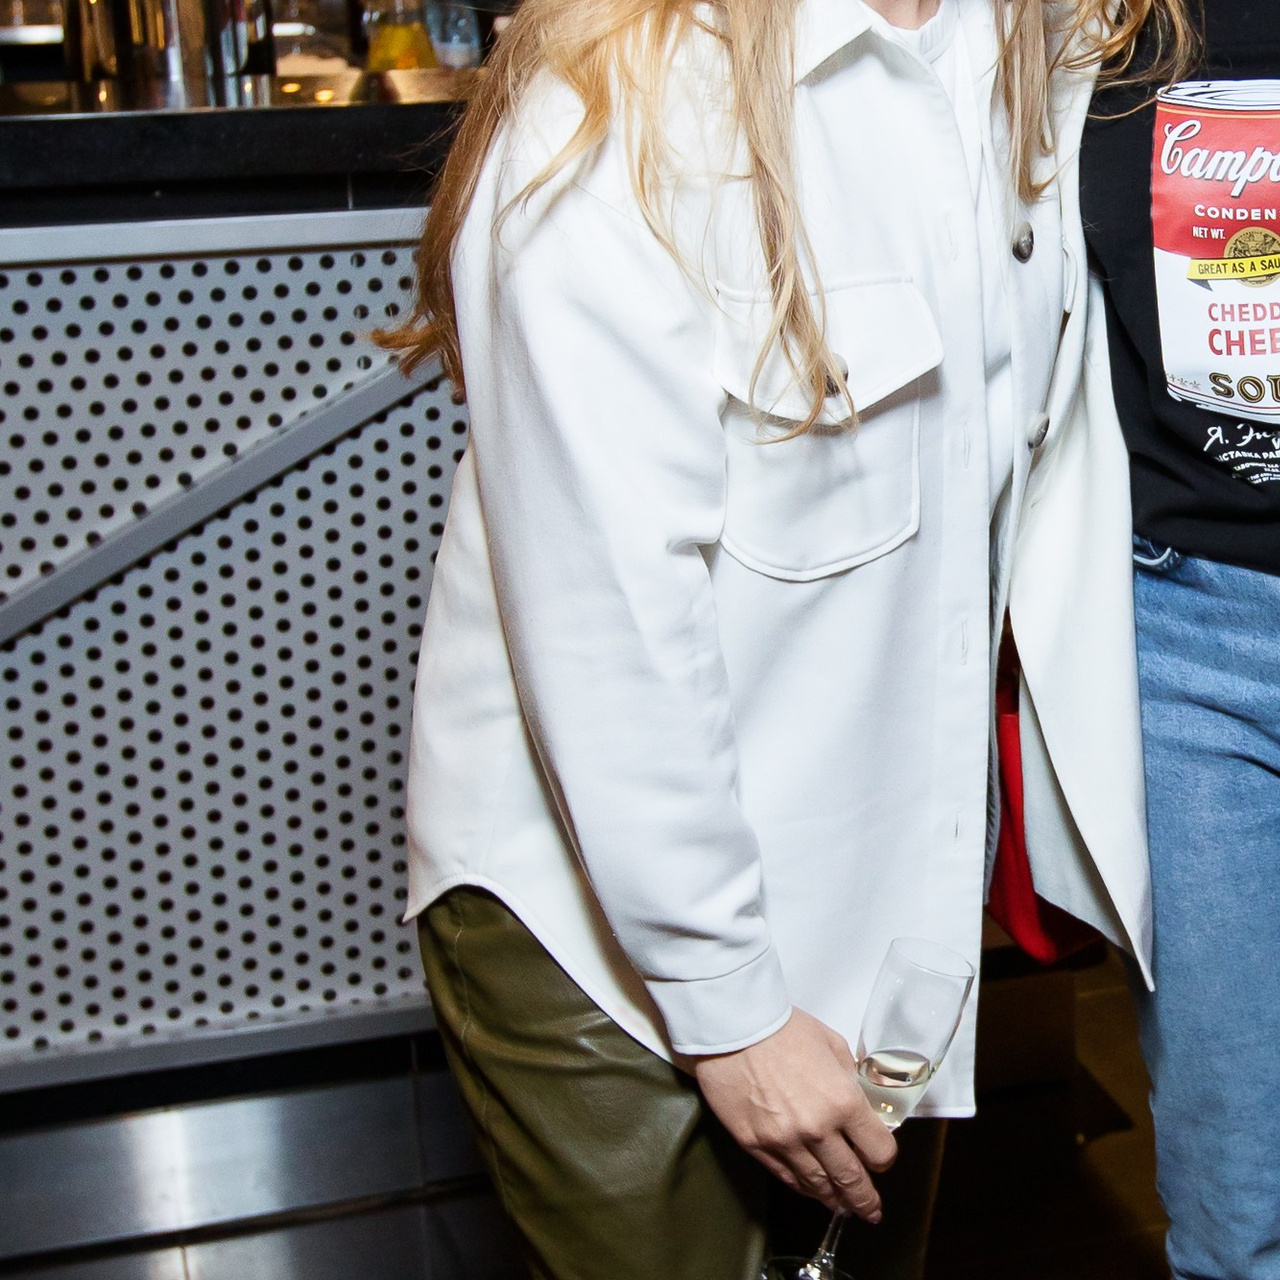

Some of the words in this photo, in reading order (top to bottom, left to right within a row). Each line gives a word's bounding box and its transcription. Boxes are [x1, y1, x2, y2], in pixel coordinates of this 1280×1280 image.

[1193, 226, 1208, 238] NET
[1210, 228, 1226, 239] WT.
[1198, 263, 1228, 274] GREAT
[1232, 262, 1245, 273] AS
[1249, 261, 1257, 272] A
